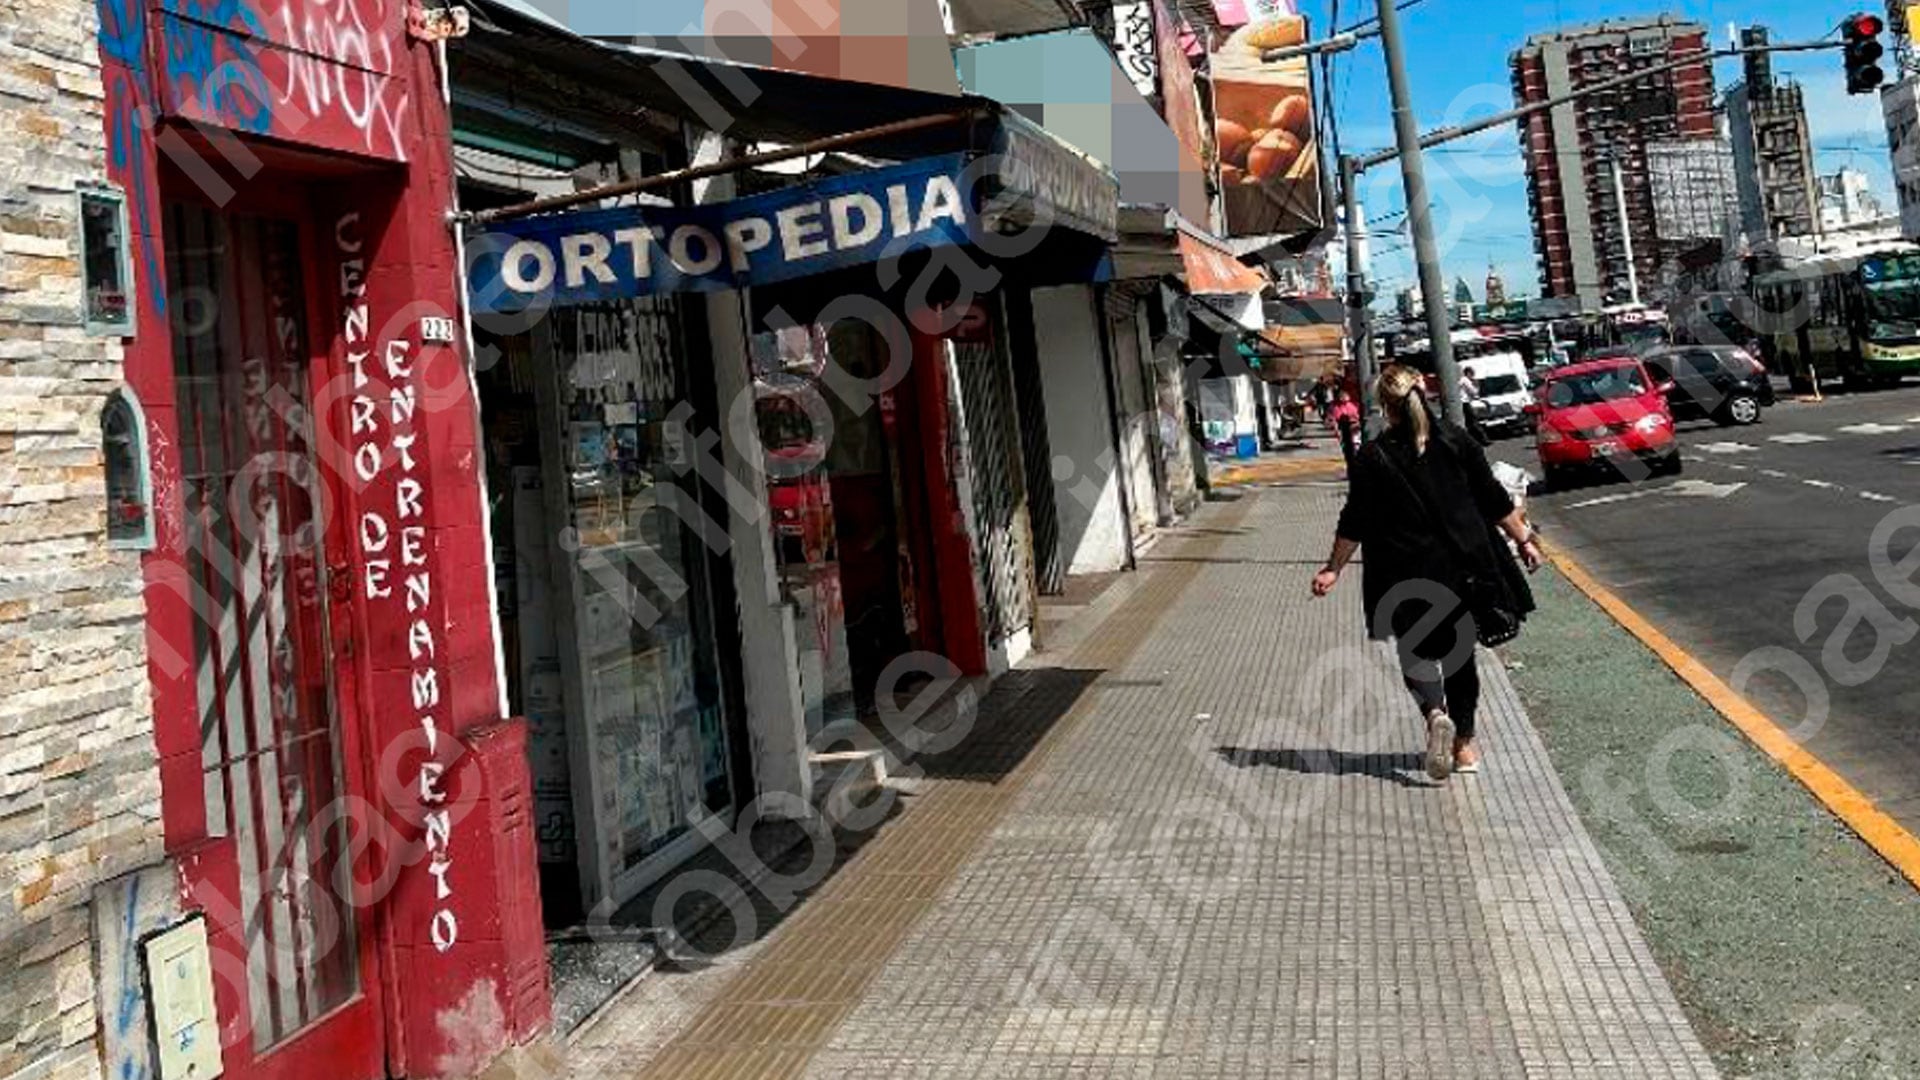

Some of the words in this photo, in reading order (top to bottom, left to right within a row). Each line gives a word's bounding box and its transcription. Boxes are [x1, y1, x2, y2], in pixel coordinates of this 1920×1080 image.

[335, 211, 382, 482] CENTRO
[359, 510, 393, 600] DE
[501, 174, 967, 294] ORTOPEDIA
[385, 340, 459, 954] ENTRENAMIENTO
